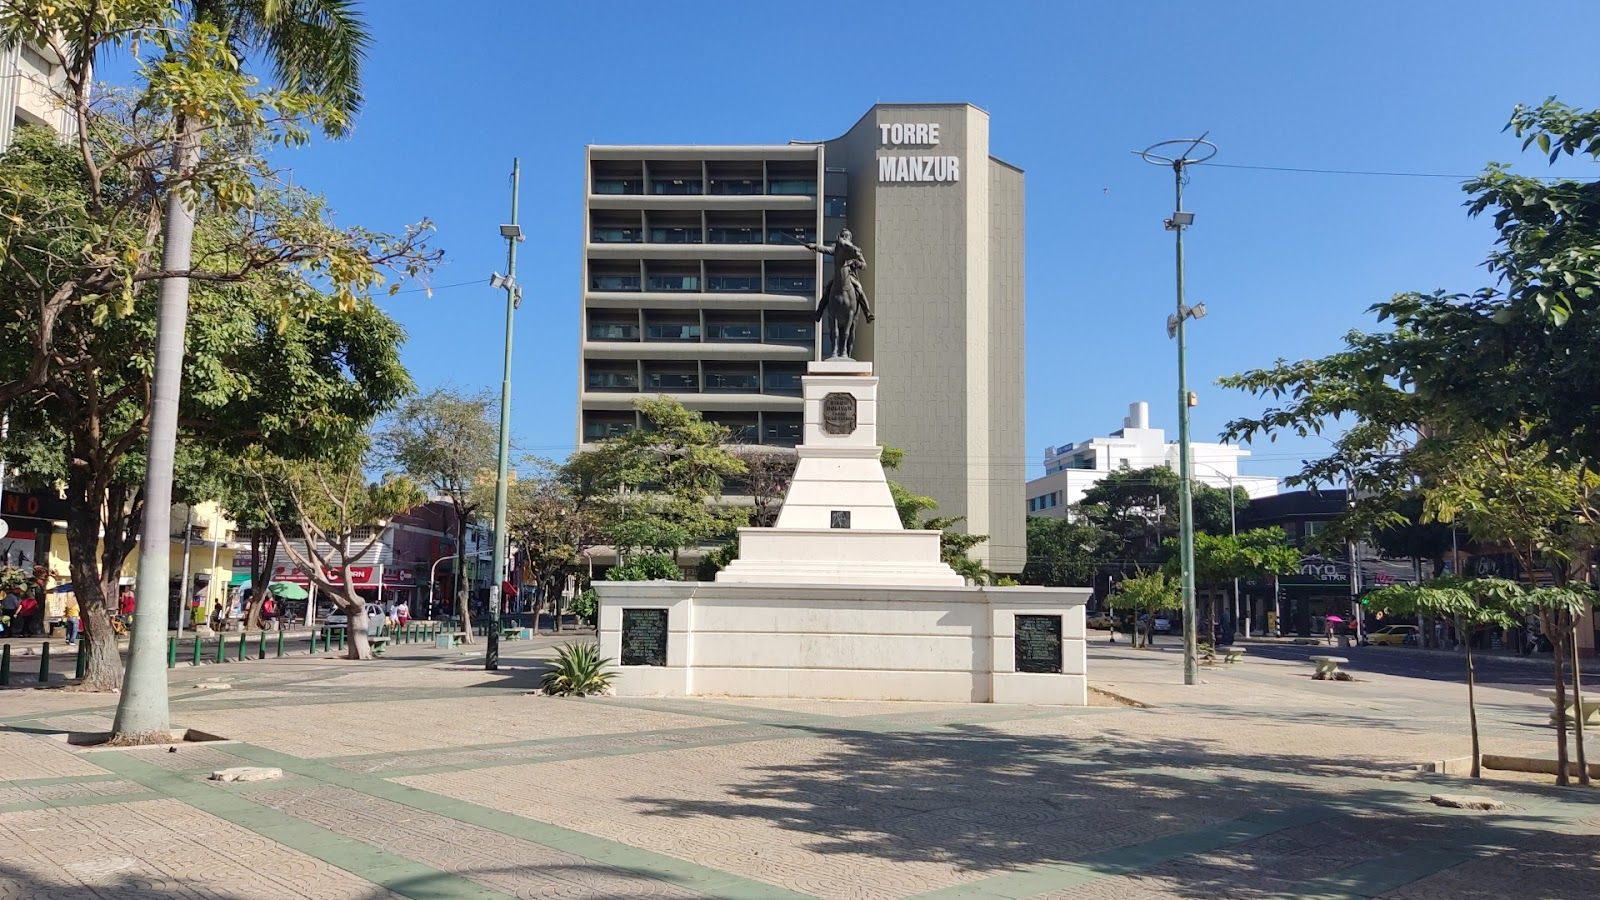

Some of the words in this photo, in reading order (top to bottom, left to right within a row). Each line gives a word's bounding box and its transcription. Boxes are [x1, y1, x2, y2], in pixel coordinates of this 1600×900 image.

[879, 123, 940, 145] TORRE
[879, 156, 960, 182] MANZUR
[1321, 573, 1347, 581] STAR
